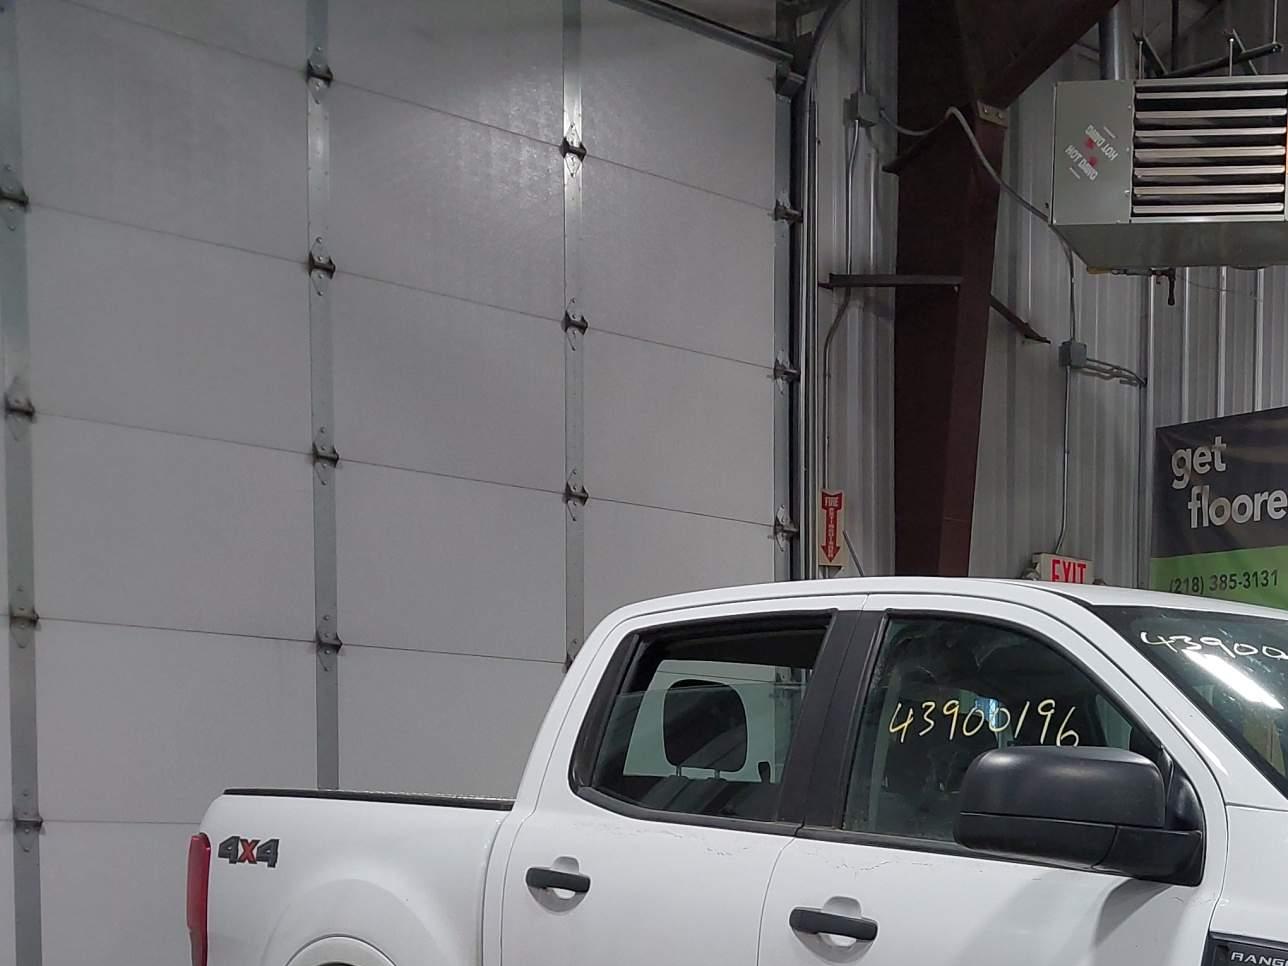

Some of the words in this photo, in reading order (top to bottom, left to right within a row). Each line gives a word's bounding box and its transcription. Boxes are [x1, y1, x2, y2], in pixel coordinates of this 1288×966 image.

[1170, 435, 1227, 490] get
[1051, 559, 1087, 584] EXIT
[1209, 569, 1279, 591] 385-3131
[889, 699, 1080, 748] 43900196
